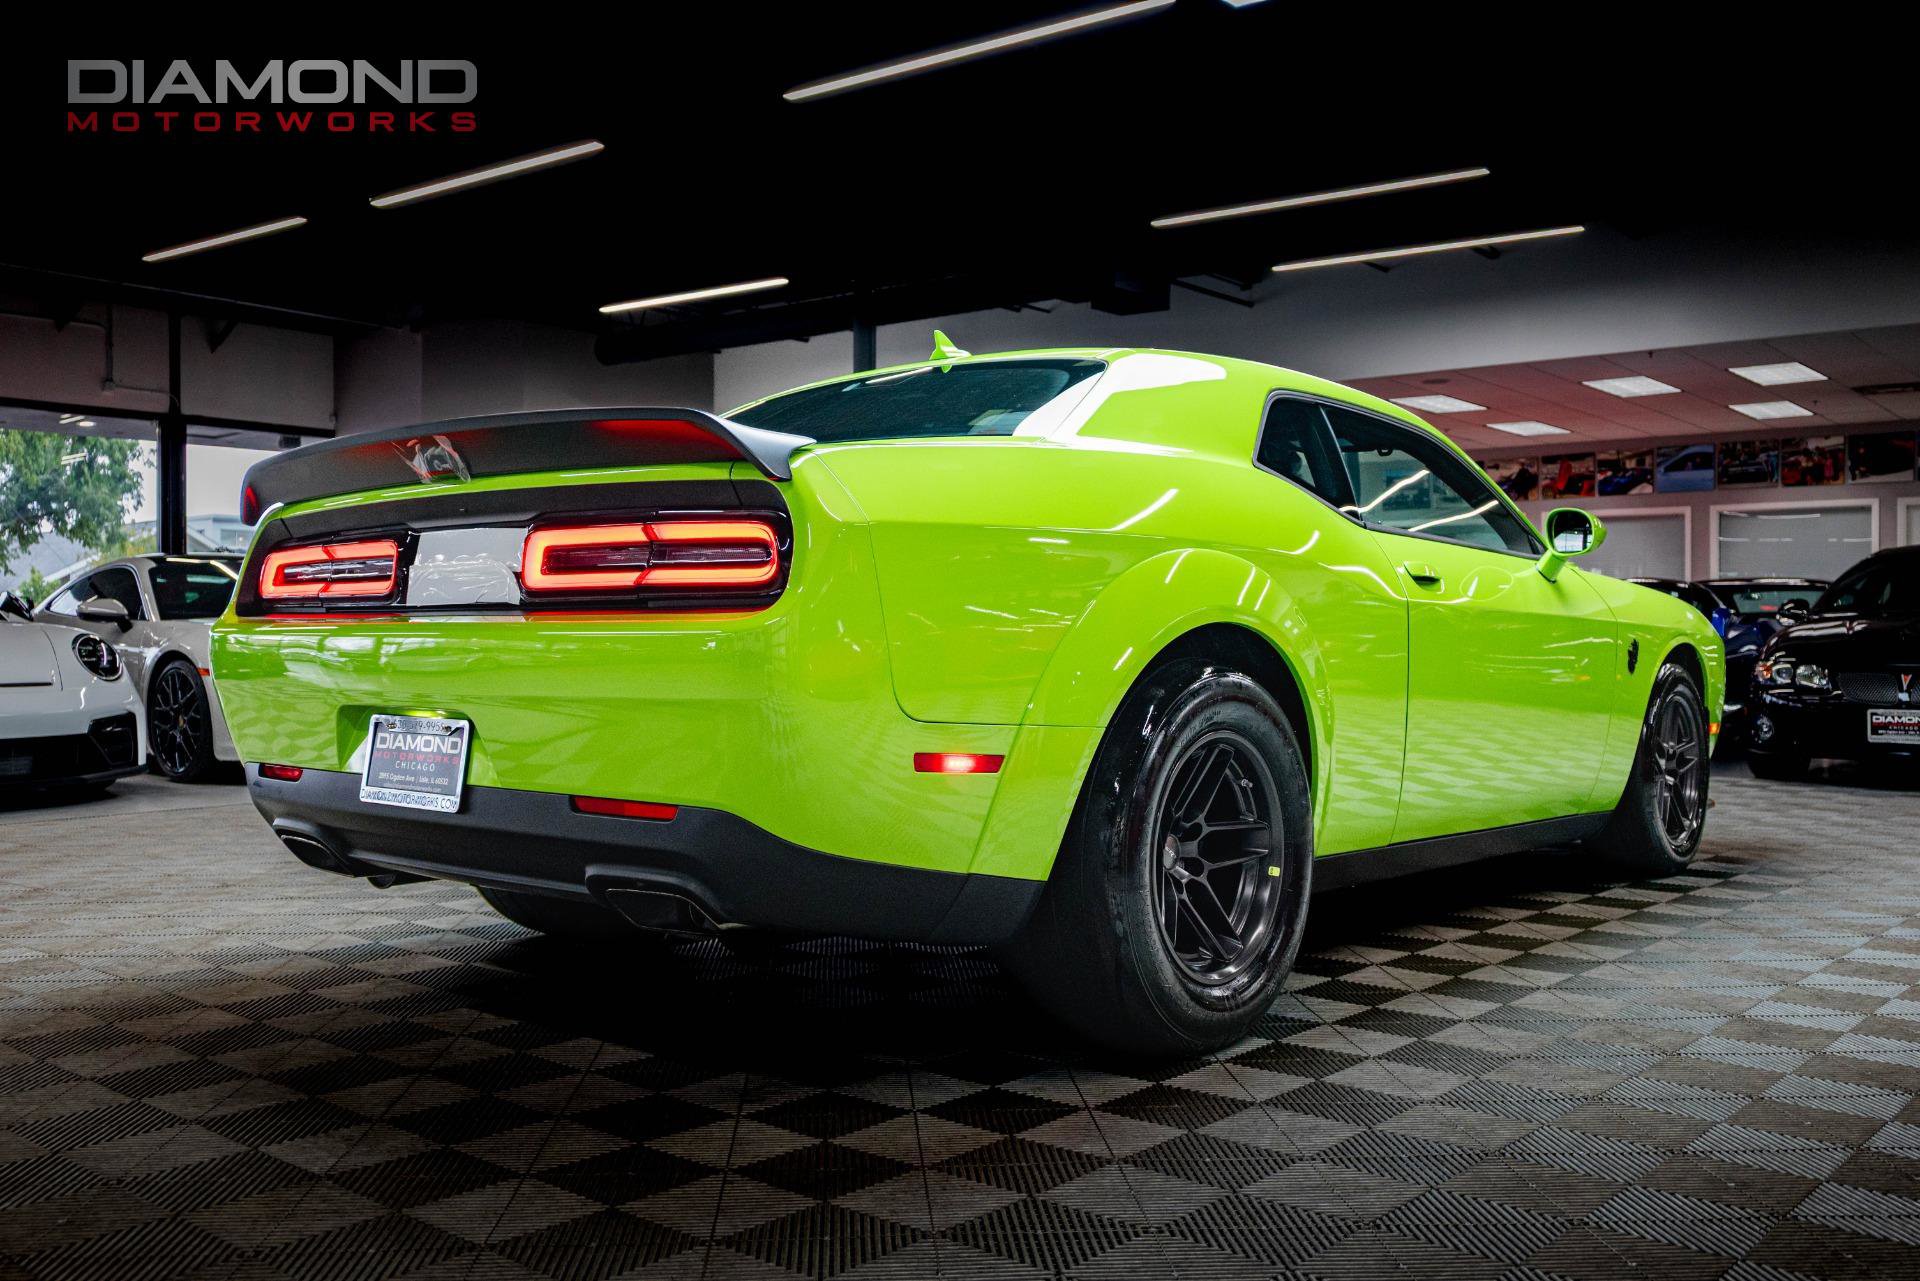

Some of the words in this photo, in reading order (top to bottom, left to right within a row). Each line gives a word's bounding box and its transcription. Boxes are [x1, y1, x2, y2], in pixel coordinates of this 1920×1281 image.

[376, 732, 461, 754] DIAMOND
[373, 751, 460, 765] MOTORWORKS
[395, 761, 435, 772] CHICAGO
